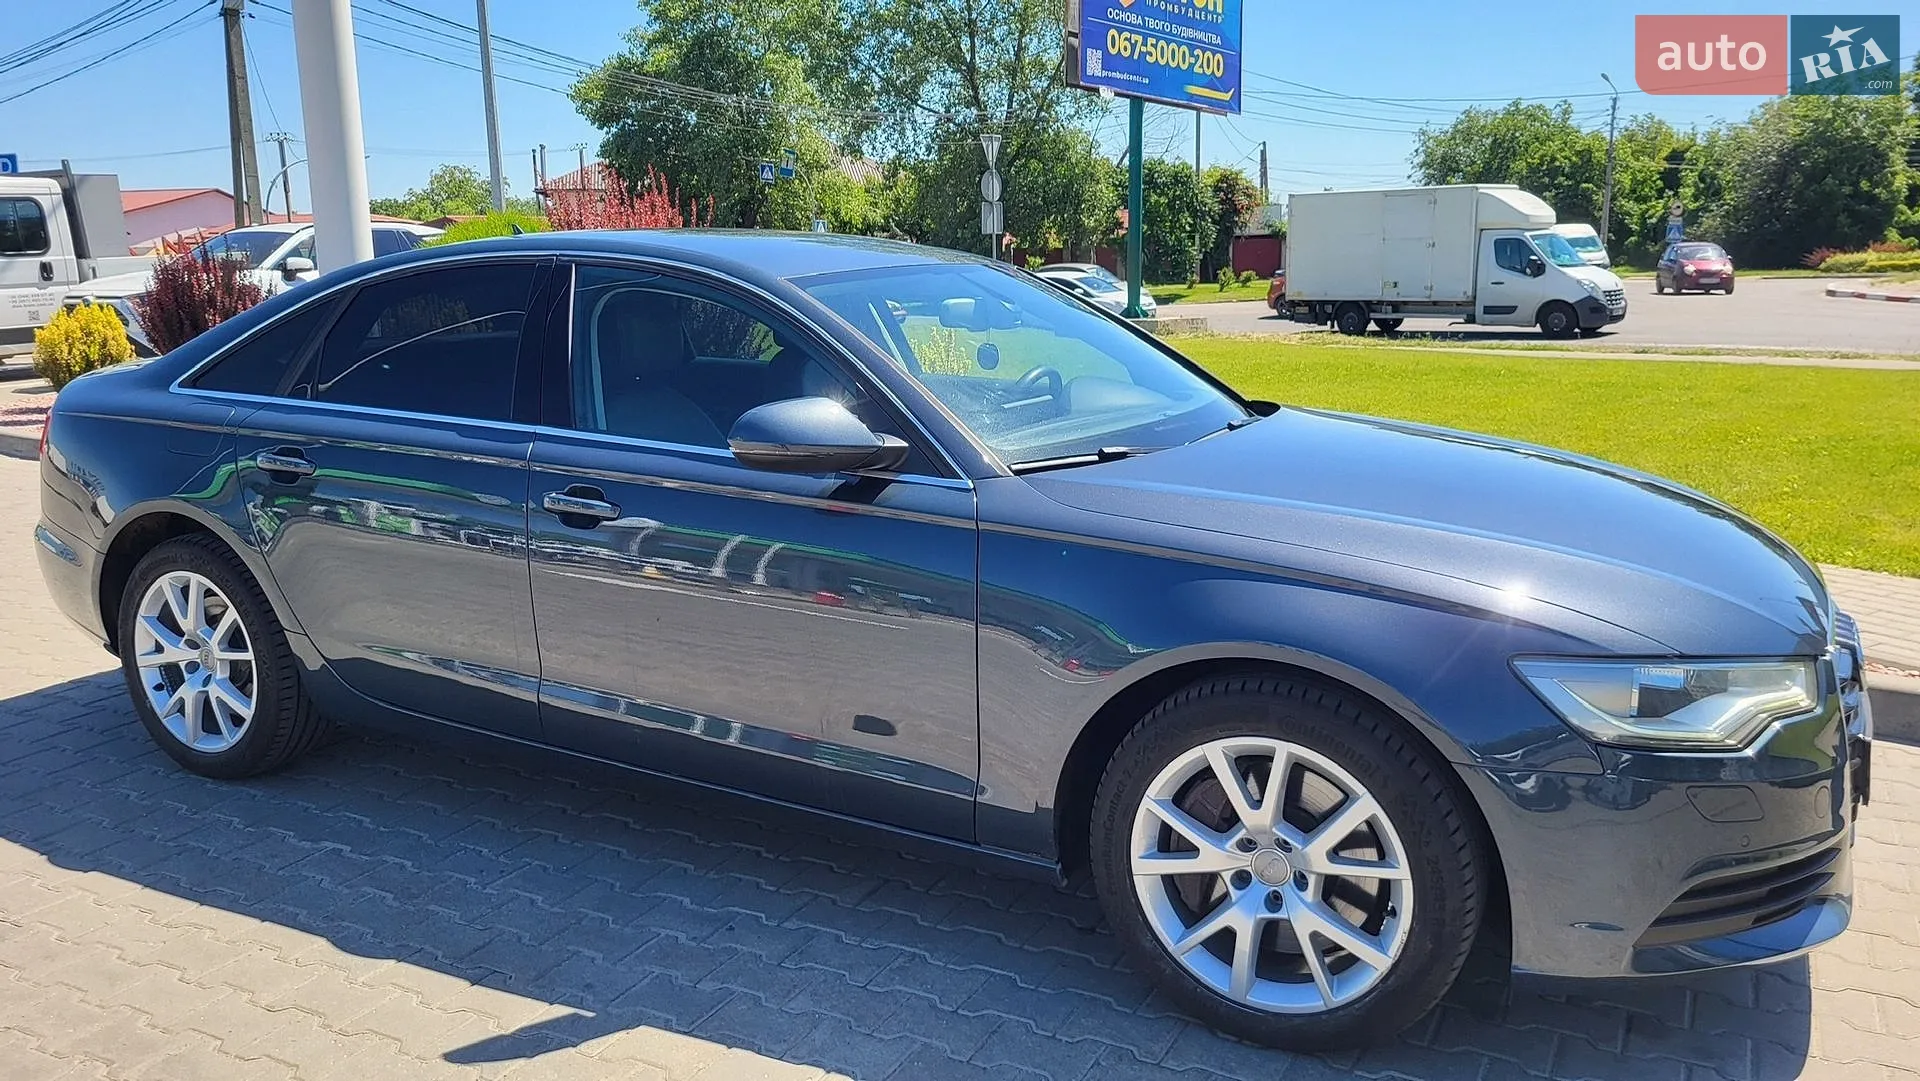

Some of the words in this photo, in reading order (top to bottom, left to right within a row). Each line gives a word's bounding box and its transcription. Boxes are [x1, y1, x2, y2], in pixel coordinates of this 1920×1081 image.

[1107, 8, 1142, 26] ОСНОВА
[1145, 16, 1171, 32] ТВОГО
[1172, 25, 1222, 45] БУДІВНИЦТВА
[1107, 28, 1224, 78] 067-5000-200
[1102, 69, 1149, 84] prombudcentr.ua
